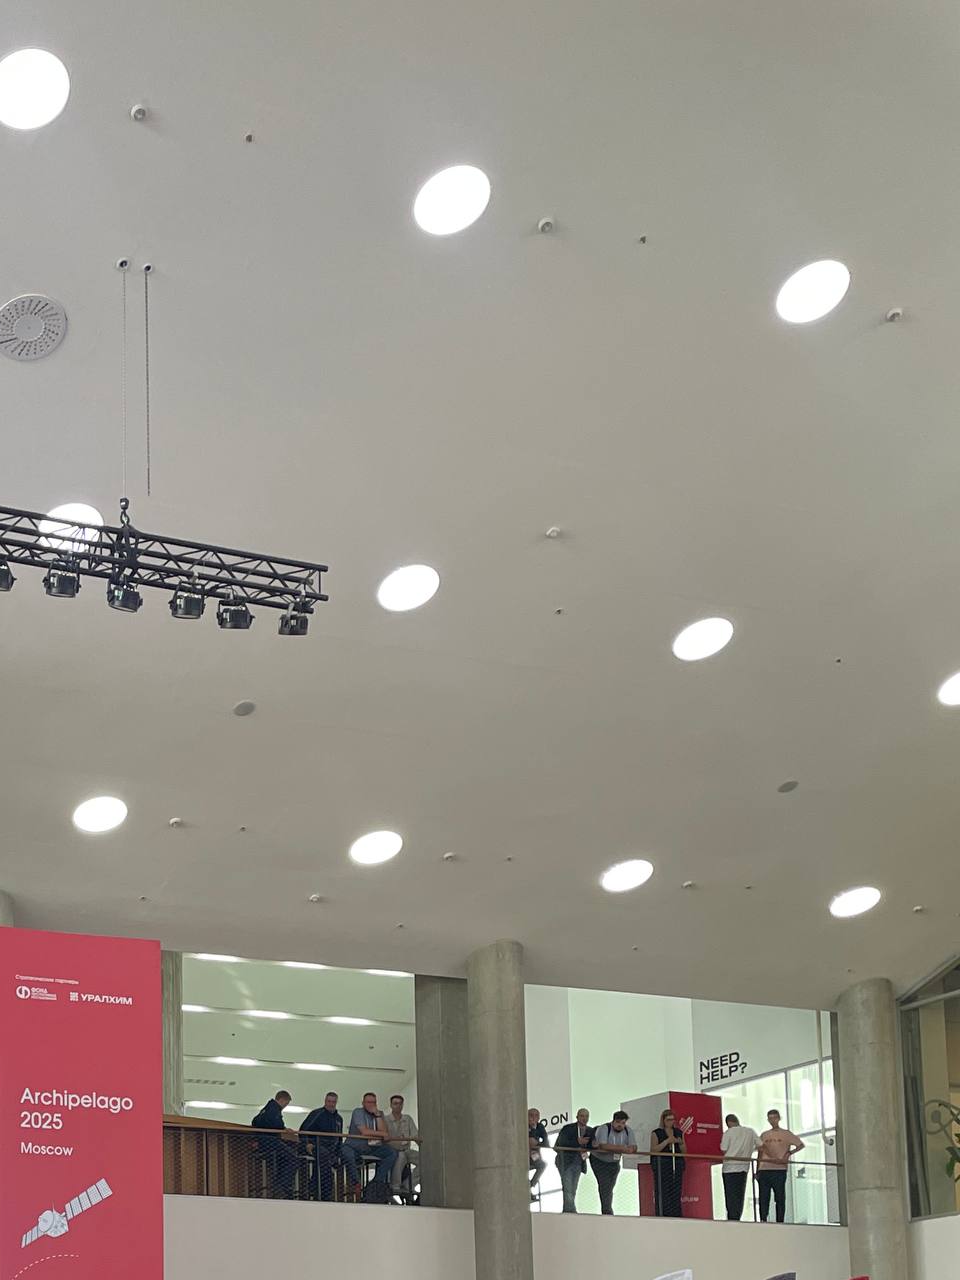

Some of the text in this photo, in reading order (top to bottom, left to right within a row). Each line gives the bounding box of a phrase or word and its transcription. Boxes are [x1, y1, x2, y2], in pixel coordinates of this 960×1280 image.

[80, 993, 133, 1005] УРАЛХИМ
[700, 1051, 740, 1073] NEED
[700, 1062, 748, 1085] HELP?
[20, 1087, 134, 1114] Archipelago
[20, 1112, 63, 1130] 2025
[551, 1112, 568, 1126] ON
[20, 1142, 73, 1157] Moscow
